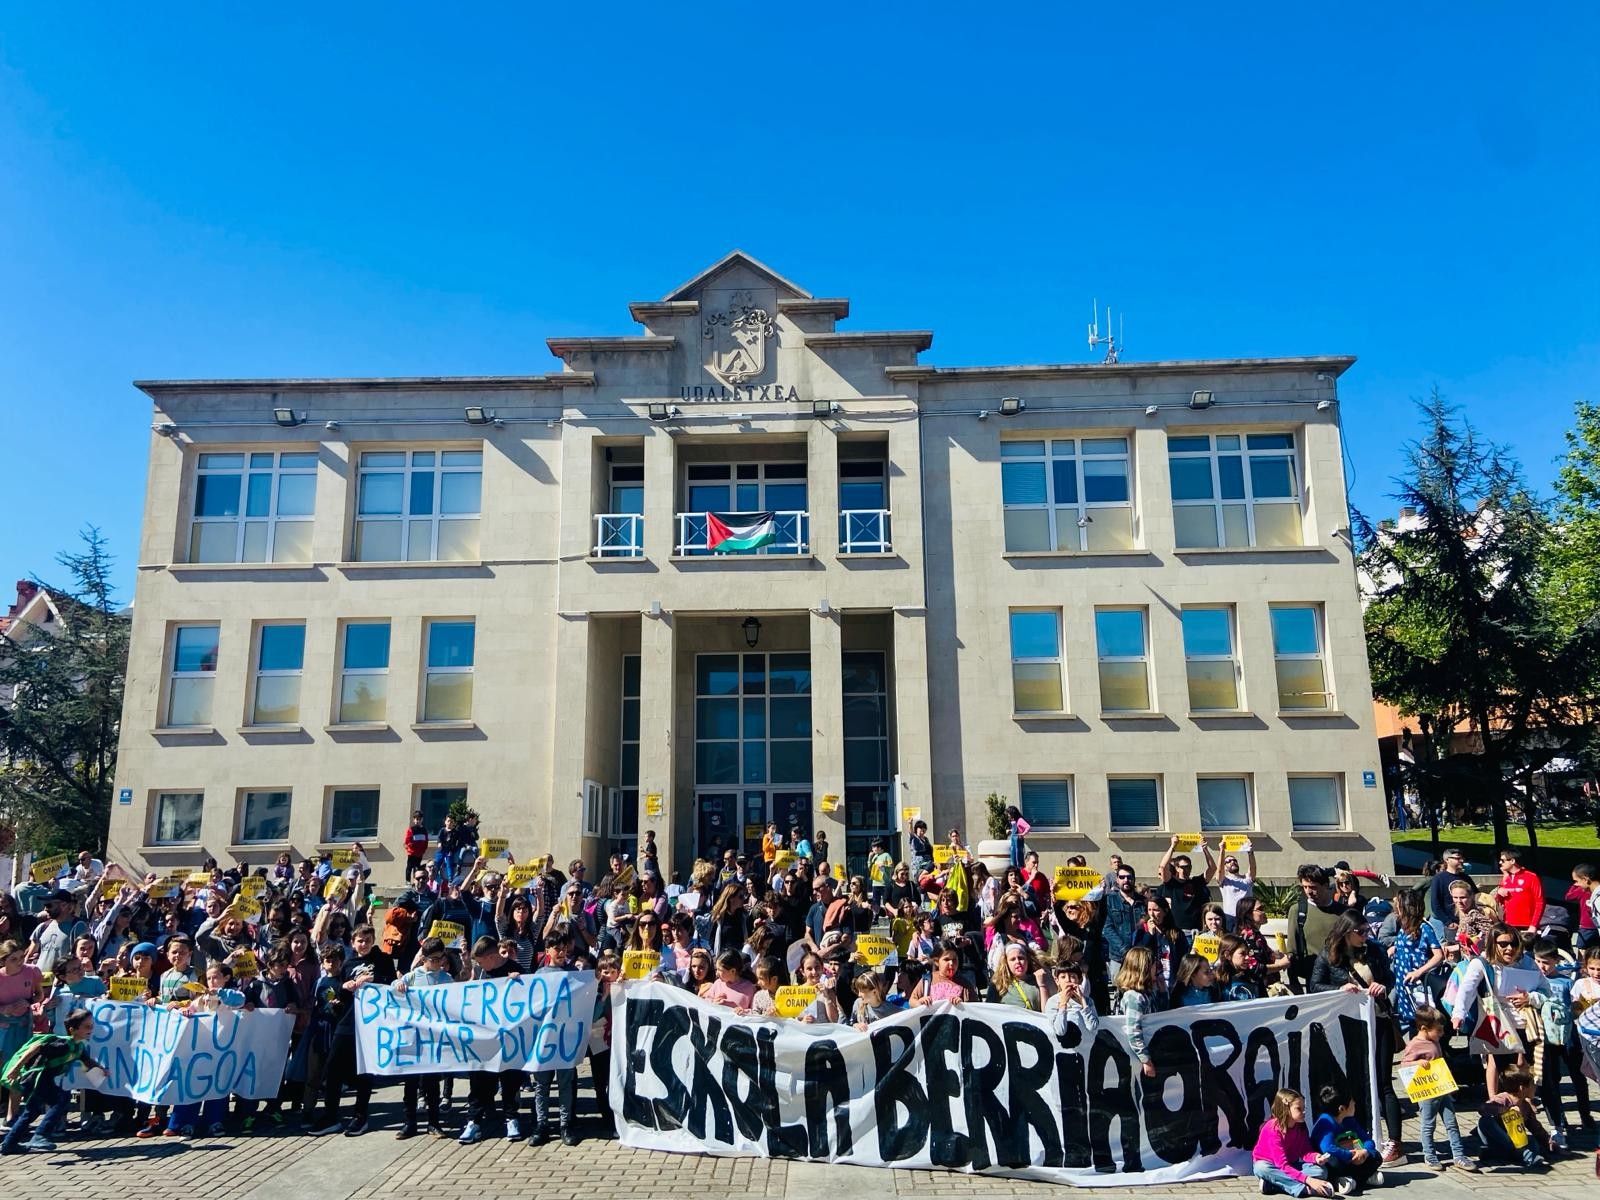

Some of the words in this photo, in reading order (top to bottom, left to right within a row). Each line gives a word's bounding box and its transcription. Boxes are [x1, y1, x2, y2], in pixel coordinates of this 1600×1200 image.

[681, 385, 800, 401] UDALETXEA
[1067, 880, 1093, 889] ORAIN
[438, 931, 457, 939] ORAIN
[868, 946, 890, 955] ORAIN
[1204, 946, 1217, 954] ORA
[632, 961, 653, 971] ORAIN
[119, 987, 139, 996] ORAIN
[779, 987, 797, 995] SKOLA
[359, 977, 572, 1025] BATXILERGOA
[786, 998, 809, 1008] ORAIN
[70, 1000, 241, 1053] STITUTU
[376, 1025, 481, 1069] BEHAR
[499, 1021, 584, 1065] DUGU
[623, 998, 854, 1158] ESKOLA
[1413, 1072, 1440, 1087] ORAIN
[1432, 1081, 1456, 1094] EOLA
